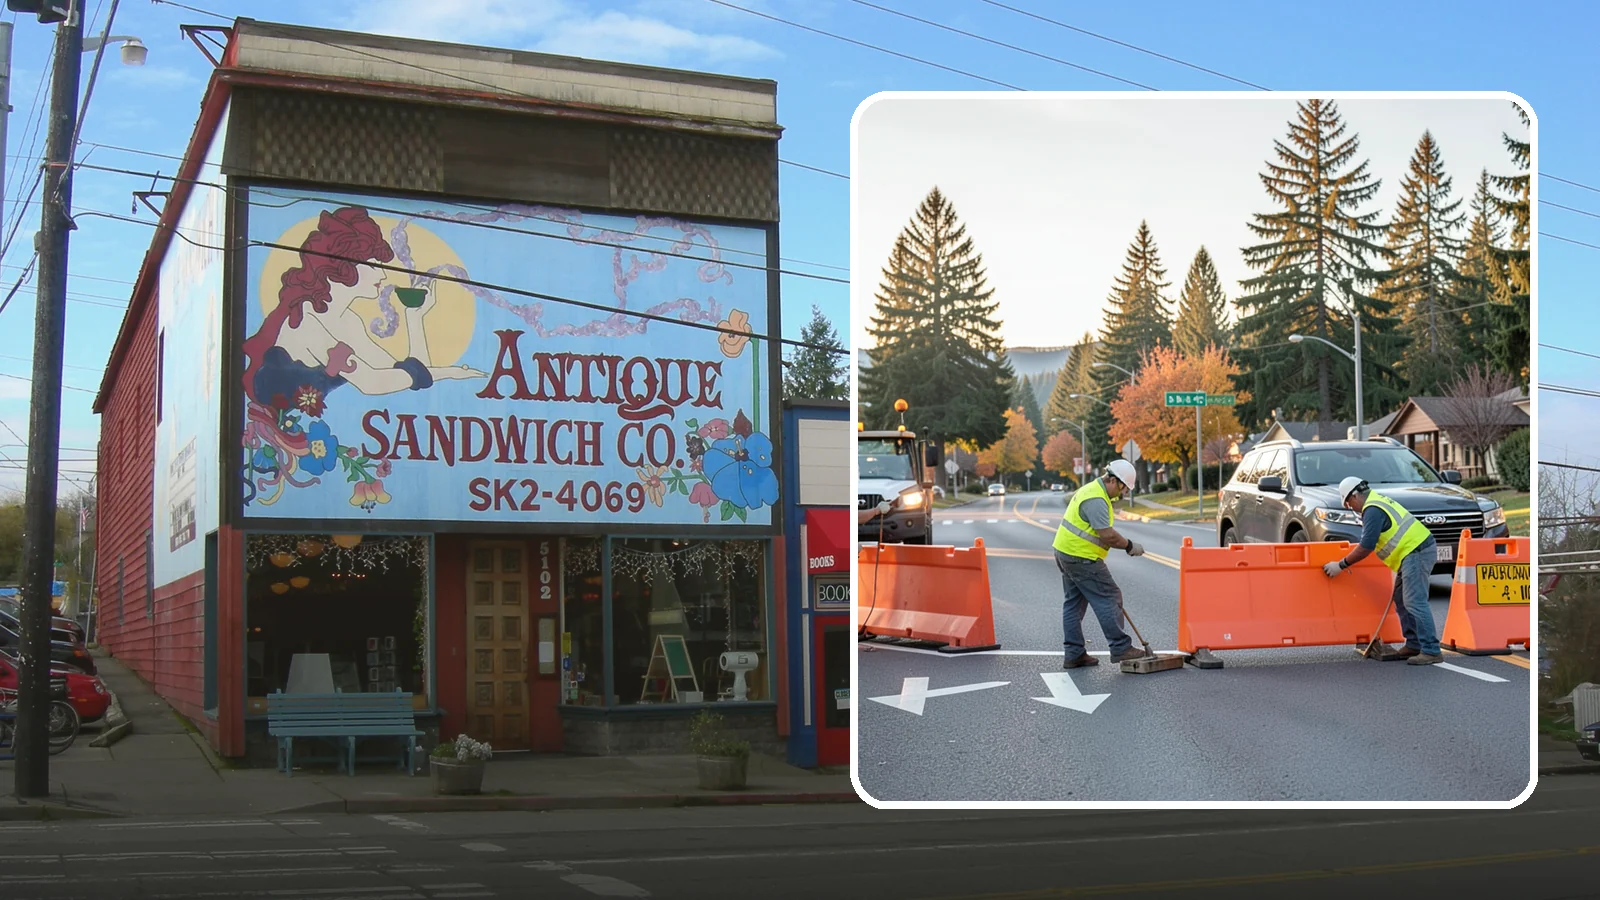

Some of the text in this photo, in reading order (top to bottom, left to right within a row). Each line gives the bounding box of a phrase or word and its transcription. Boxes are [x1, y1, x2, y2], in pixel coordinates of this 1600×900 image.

[476, 329, 724, 421] ANTIQUE
[361, 408, 685, 469] SANDWICH CO.
[468, 477, 645, 513] SK2-4069
[540, 541, 551, 599] 5102
[809, 555, 835, 569] BOOKS
